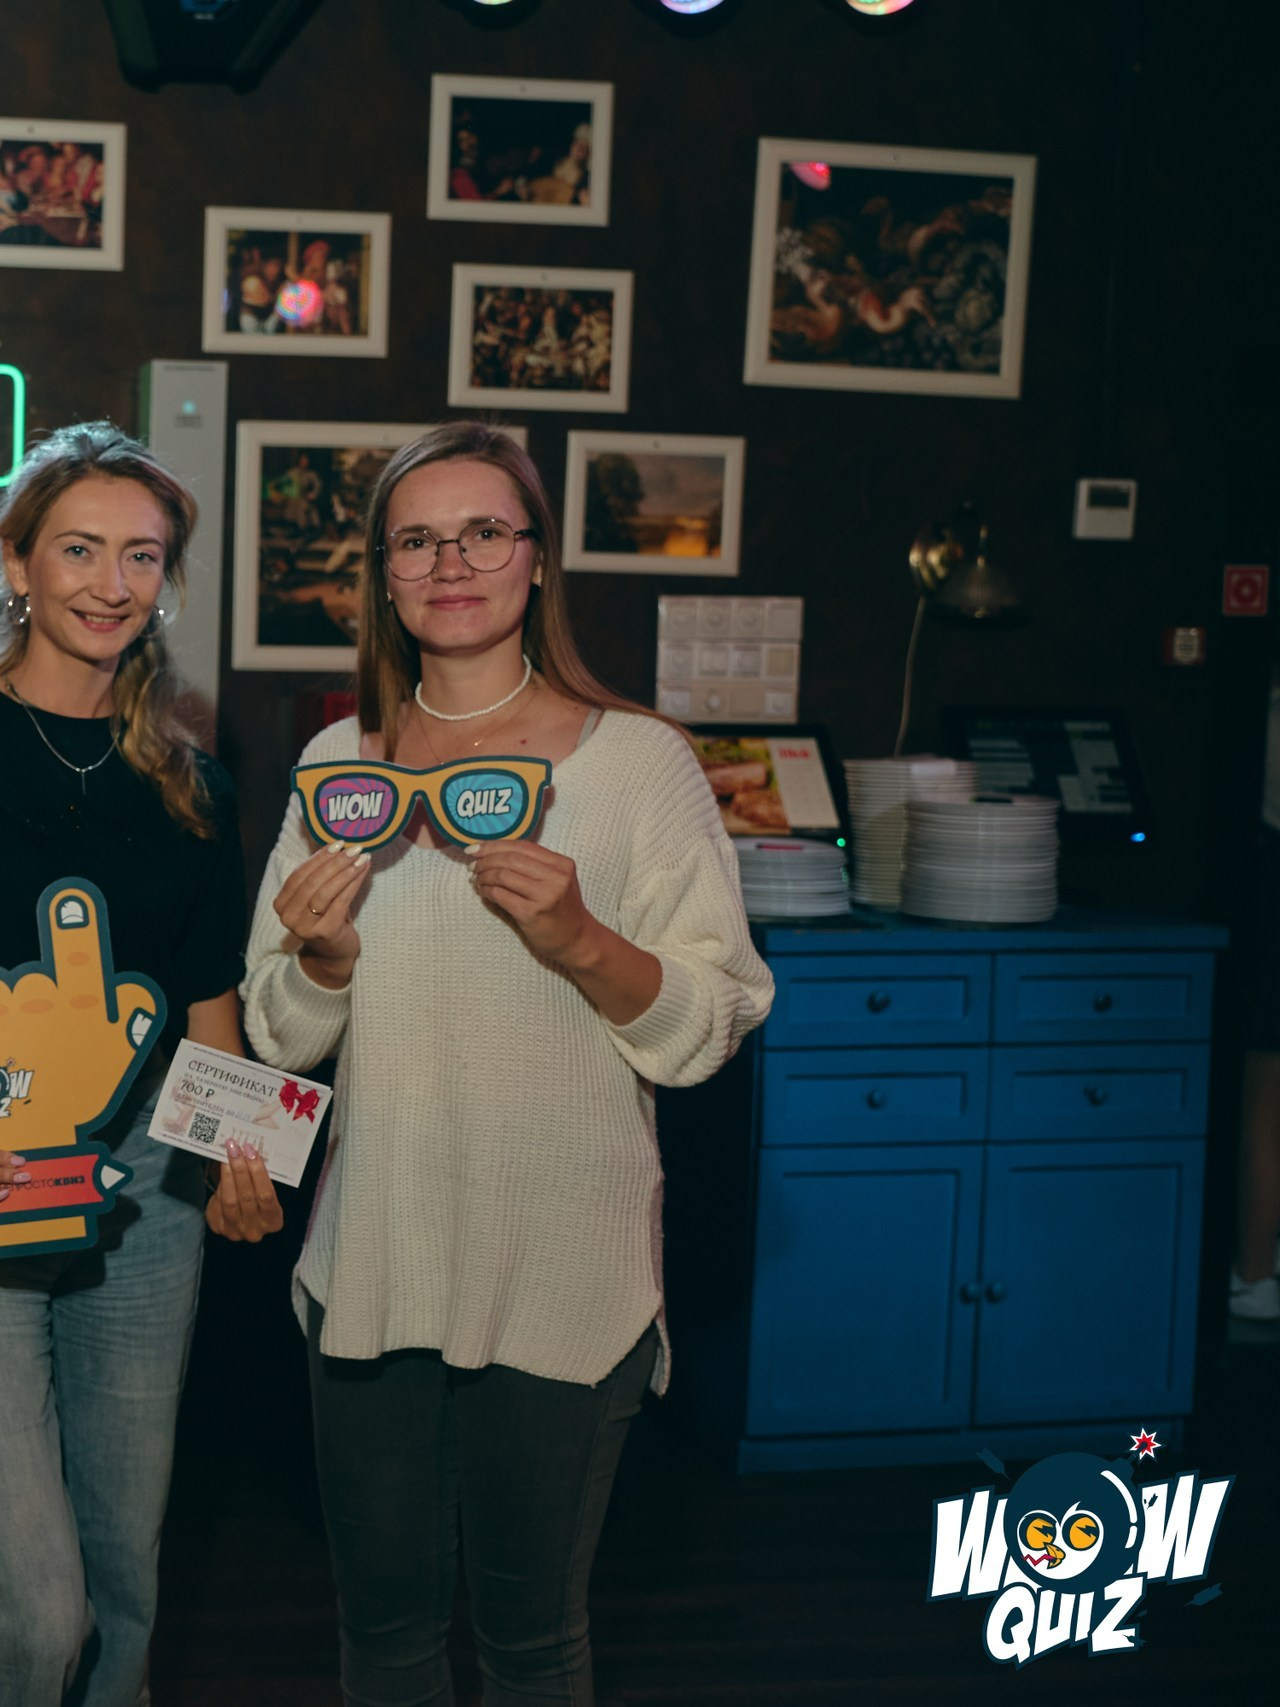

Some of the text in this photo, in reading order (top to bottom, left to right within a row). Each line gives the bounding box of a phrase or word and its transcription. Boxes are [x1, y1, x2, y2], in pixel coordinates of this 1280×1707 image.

[328, 786, 514, 824] WOW QUIZ
[179, 1079, 204, 1096] 700
[187, 1059, 277, 1098] СЕРТИФИКАТ
